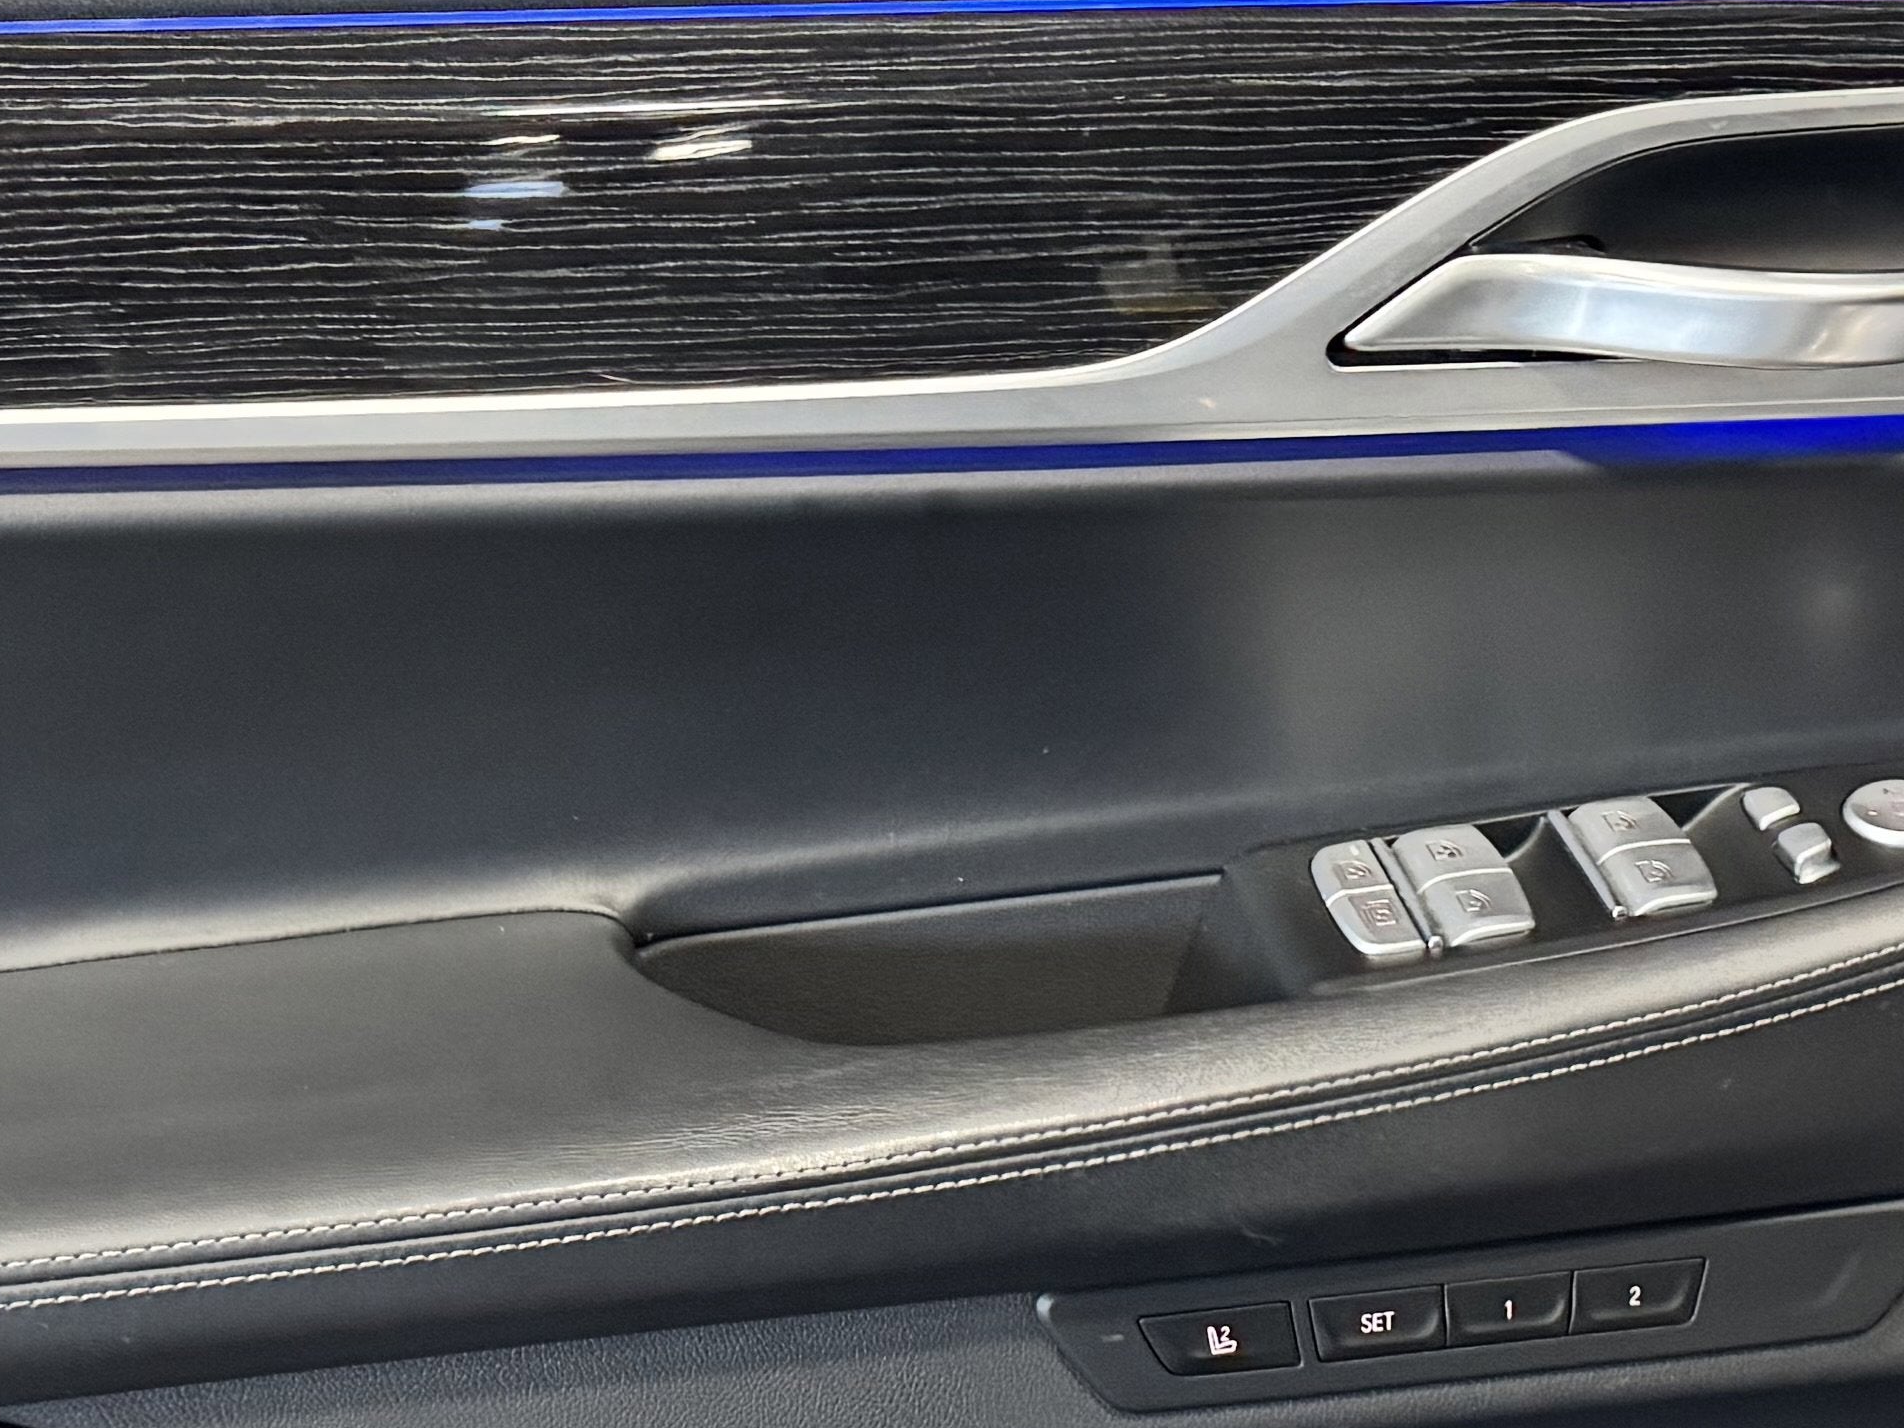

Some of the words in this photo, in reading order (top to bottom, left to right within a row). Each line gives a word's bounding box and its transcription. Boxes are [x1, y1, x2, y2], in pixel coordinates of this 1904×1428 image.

[1628, 1285, 1641, 1307] 2
[1504, 1299, 1513, 1321] 1
[1360, 1310, 1396, 1334] SET
